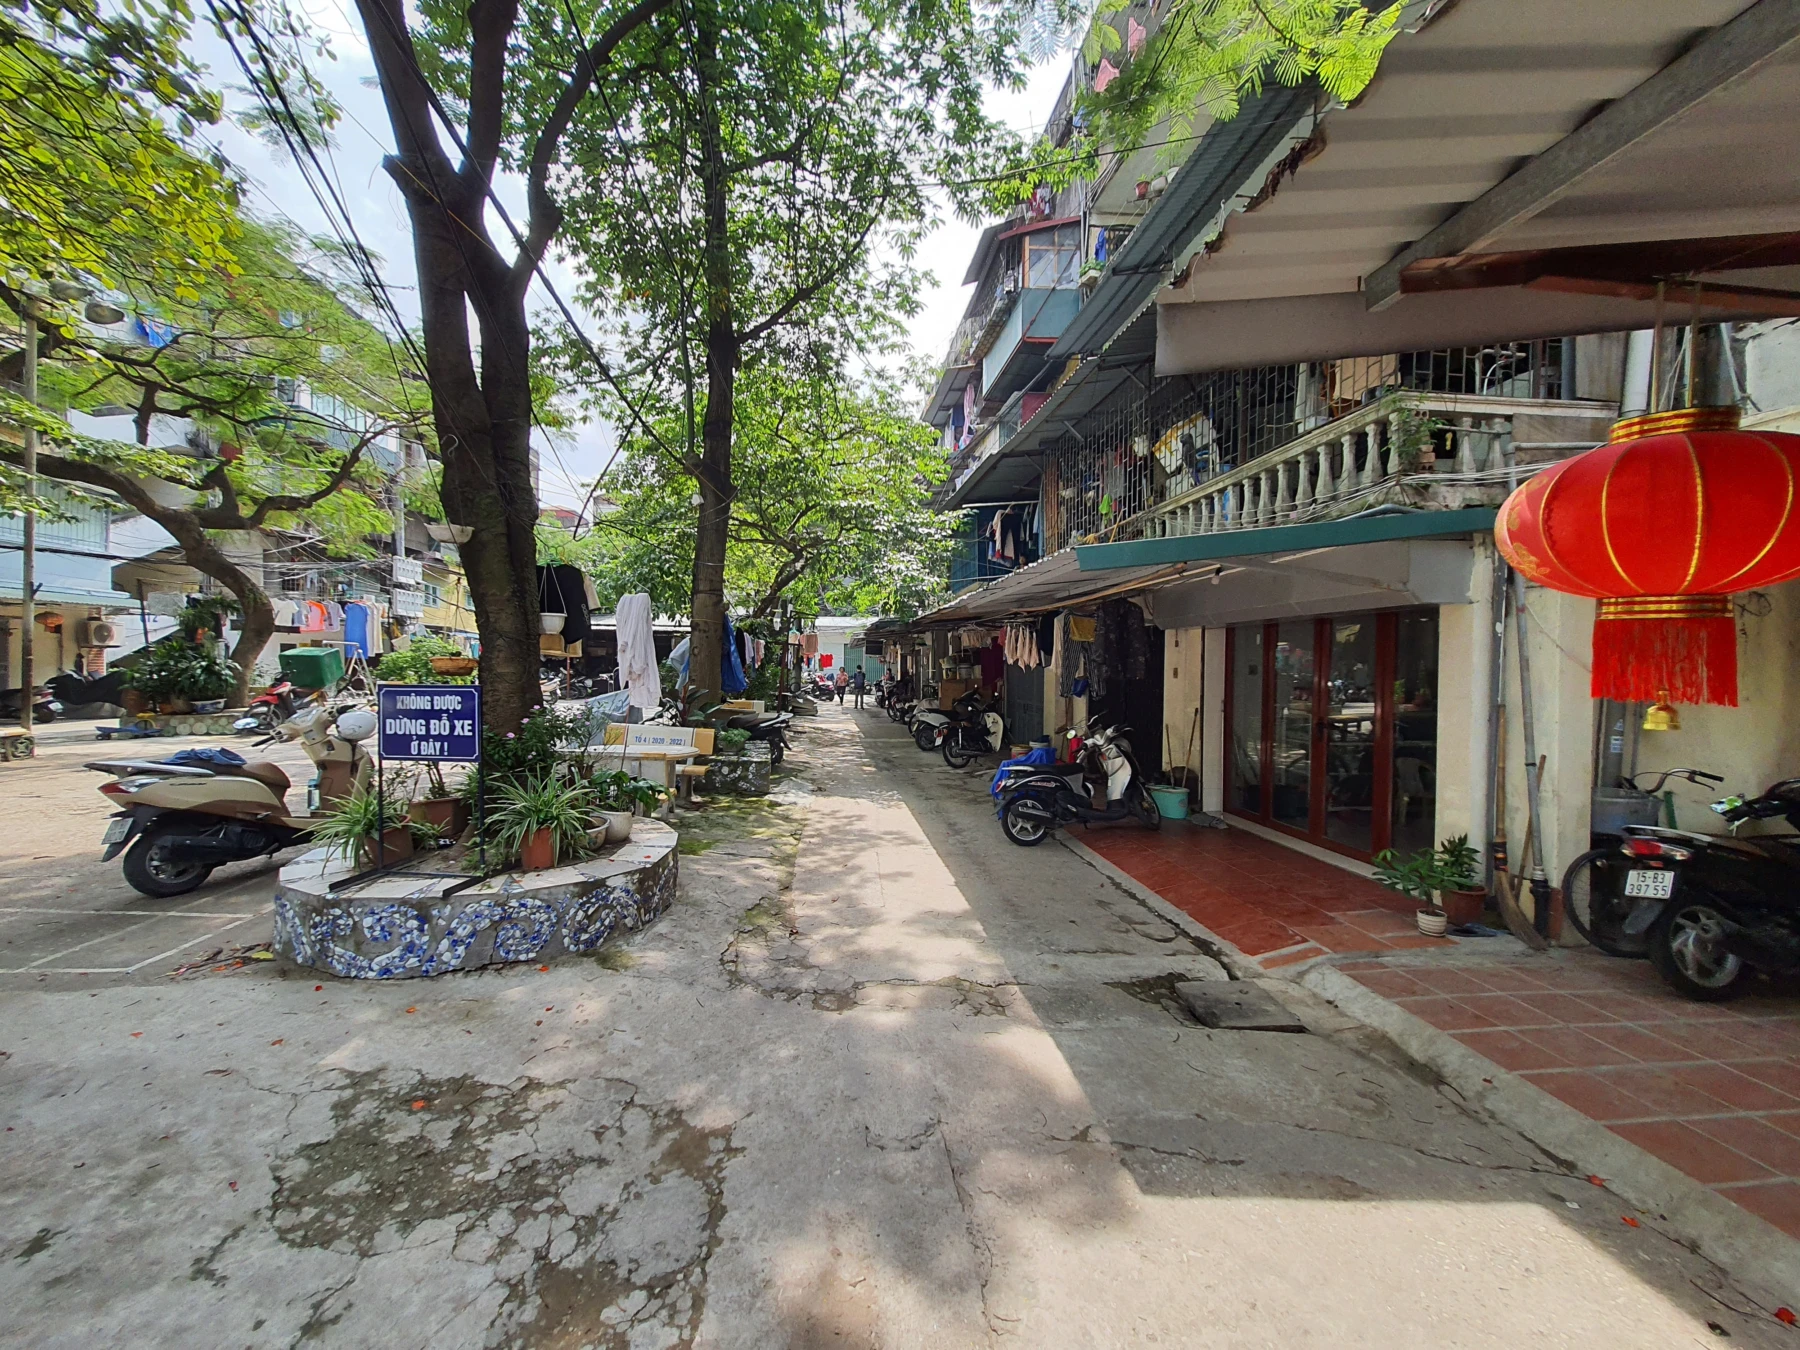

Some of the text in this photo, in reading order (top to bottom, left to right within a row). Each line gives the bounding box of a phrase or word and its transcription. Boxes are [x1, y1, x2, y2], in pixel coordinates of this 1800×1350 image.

[396, 693, 462, 713] KHÔNG ĐƯỢC
[385, 714, 473, 736] DỪNG ĐỖ XE
[411, 736, 419, 755] Ở
[420, 738, 441, 755] ĐÂY
[1636, 872, 1665, 884] 15-B3
